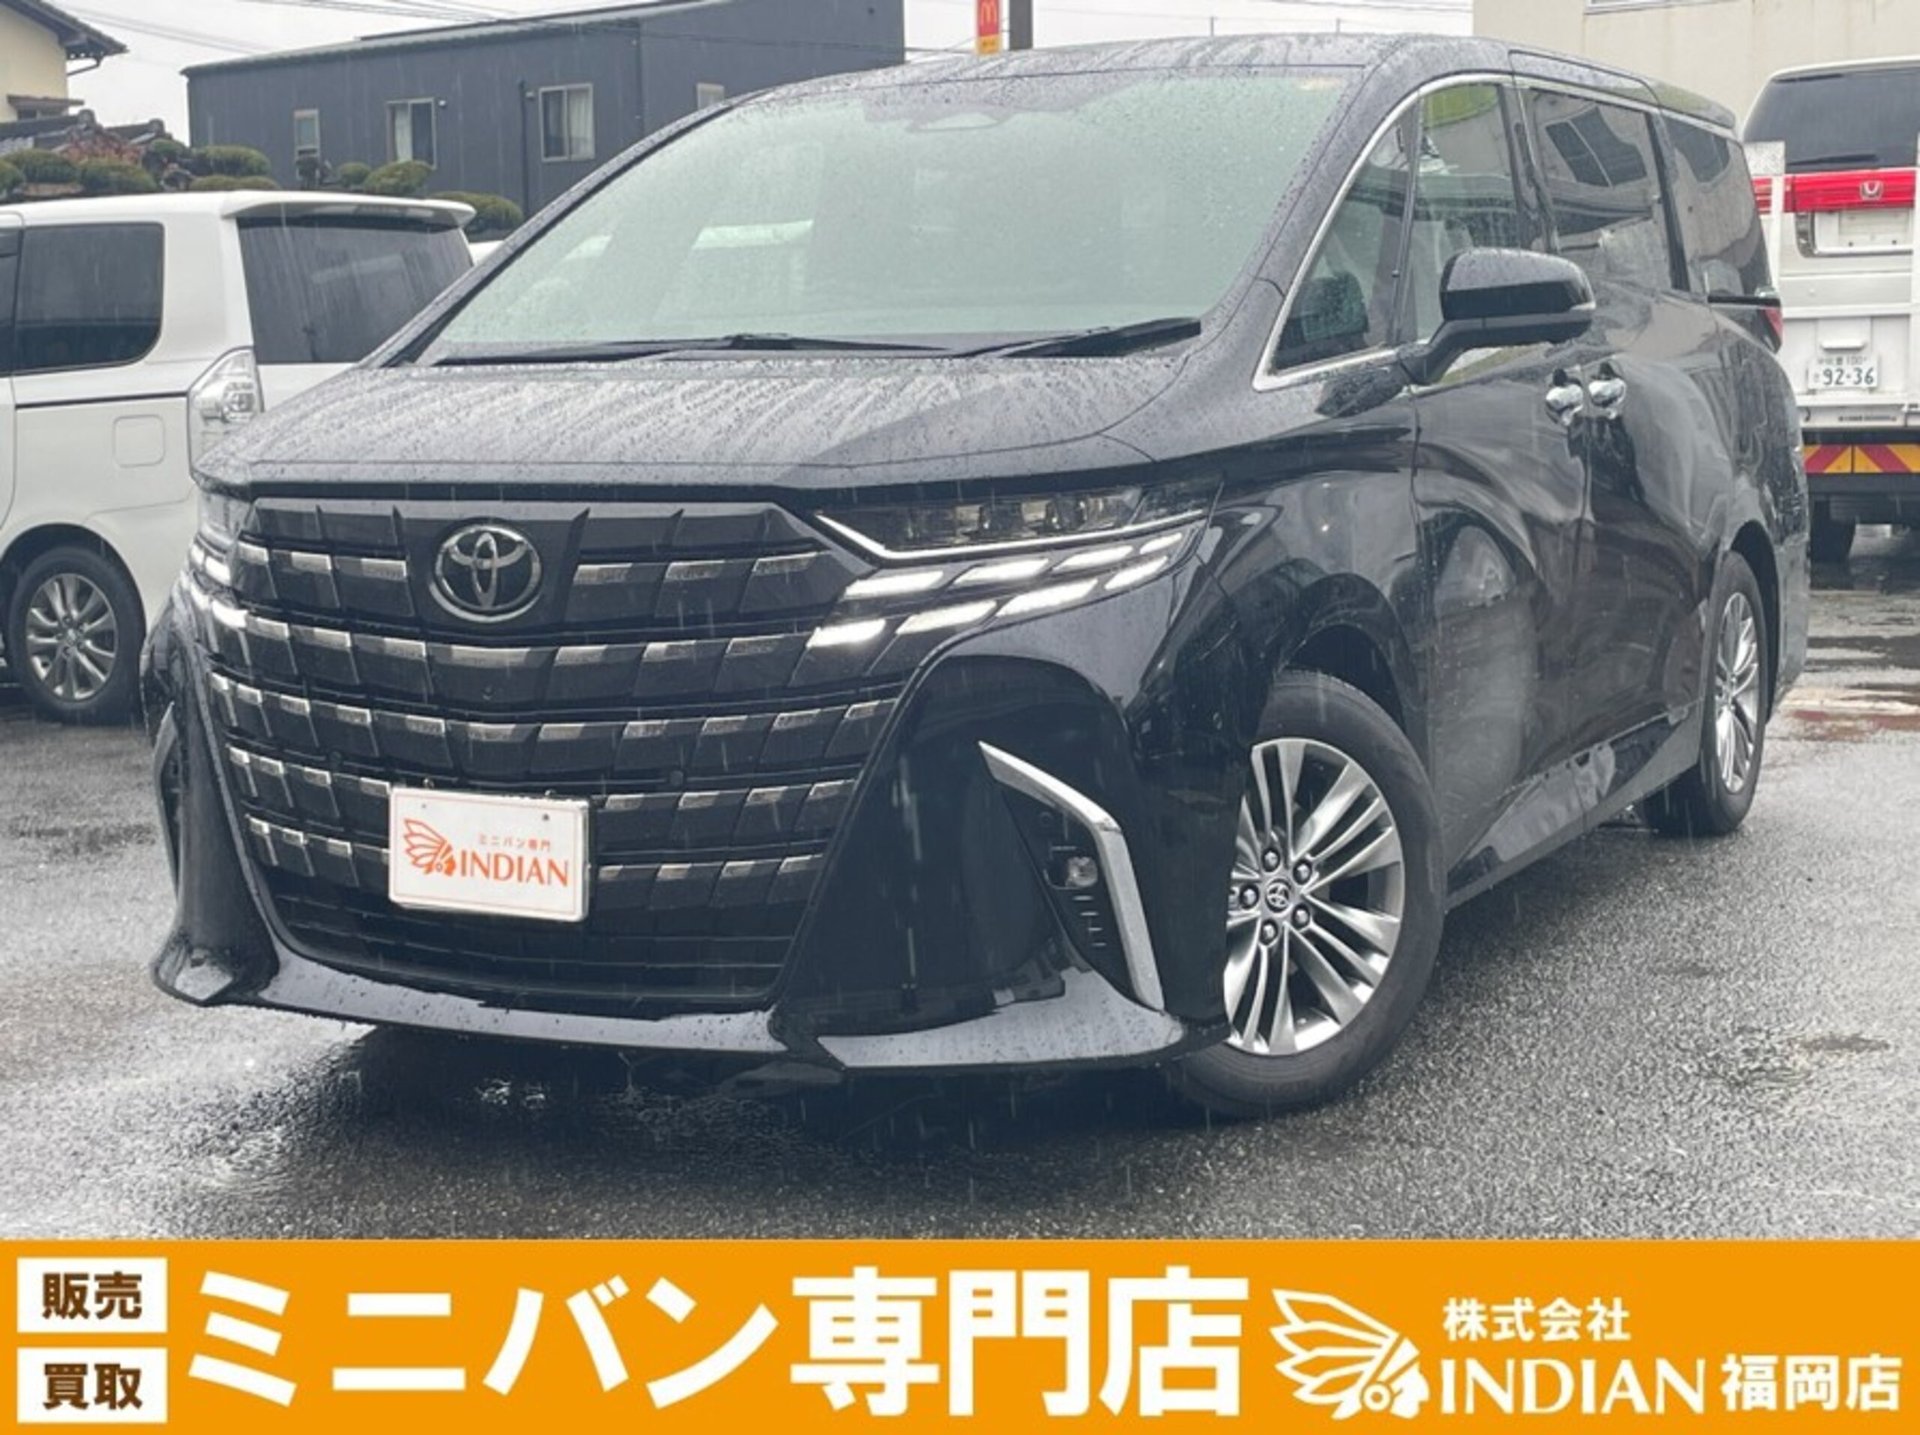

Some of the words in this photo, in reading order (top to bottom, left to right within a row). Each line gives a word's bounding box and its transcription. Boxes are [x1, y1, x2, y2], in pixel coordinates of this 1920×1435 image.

[479, 834, 551, 851] ミニバン専門
[461, 850, 569, 887] INDIAN
